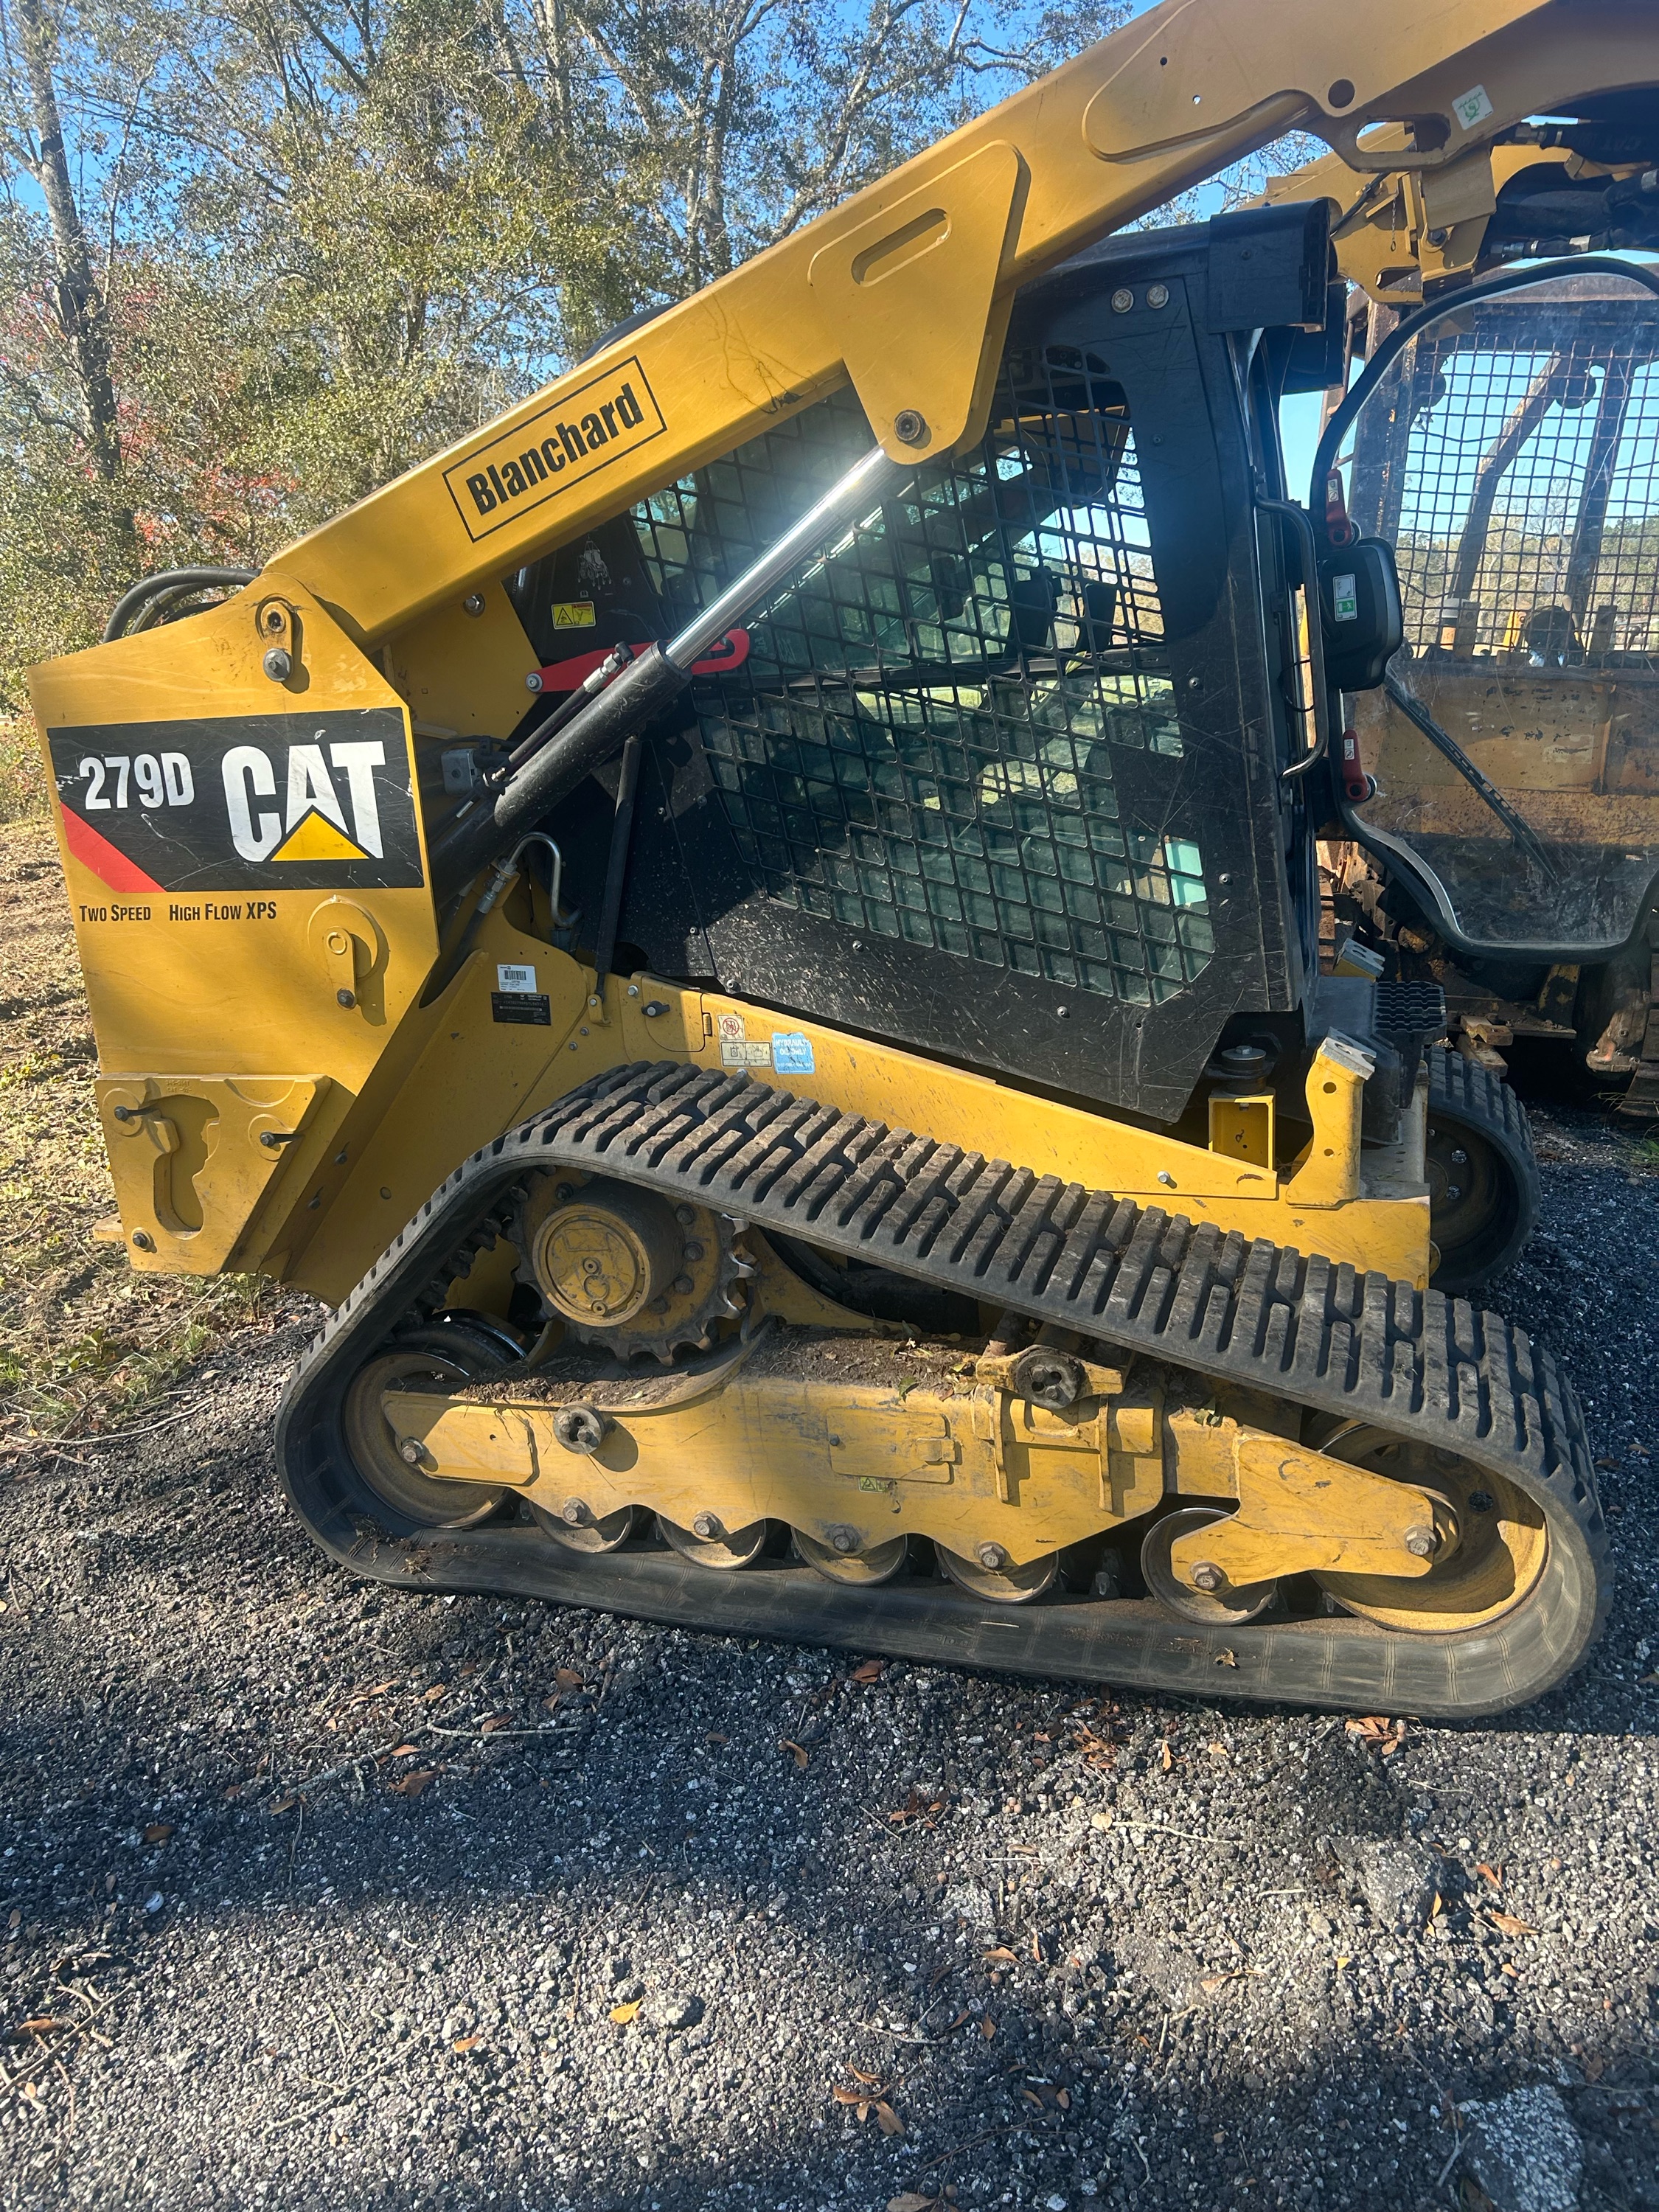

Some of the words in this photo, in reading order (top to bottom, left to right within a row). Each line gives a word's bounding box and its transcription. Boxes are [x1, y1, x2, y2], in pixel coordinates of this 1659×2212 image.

[465, 383, 644, 516] Blanchard
[79, 752, 195, 810] 279D
[220, 741, 386, 862] CAT
[246, 901, 276, 919] XPS
